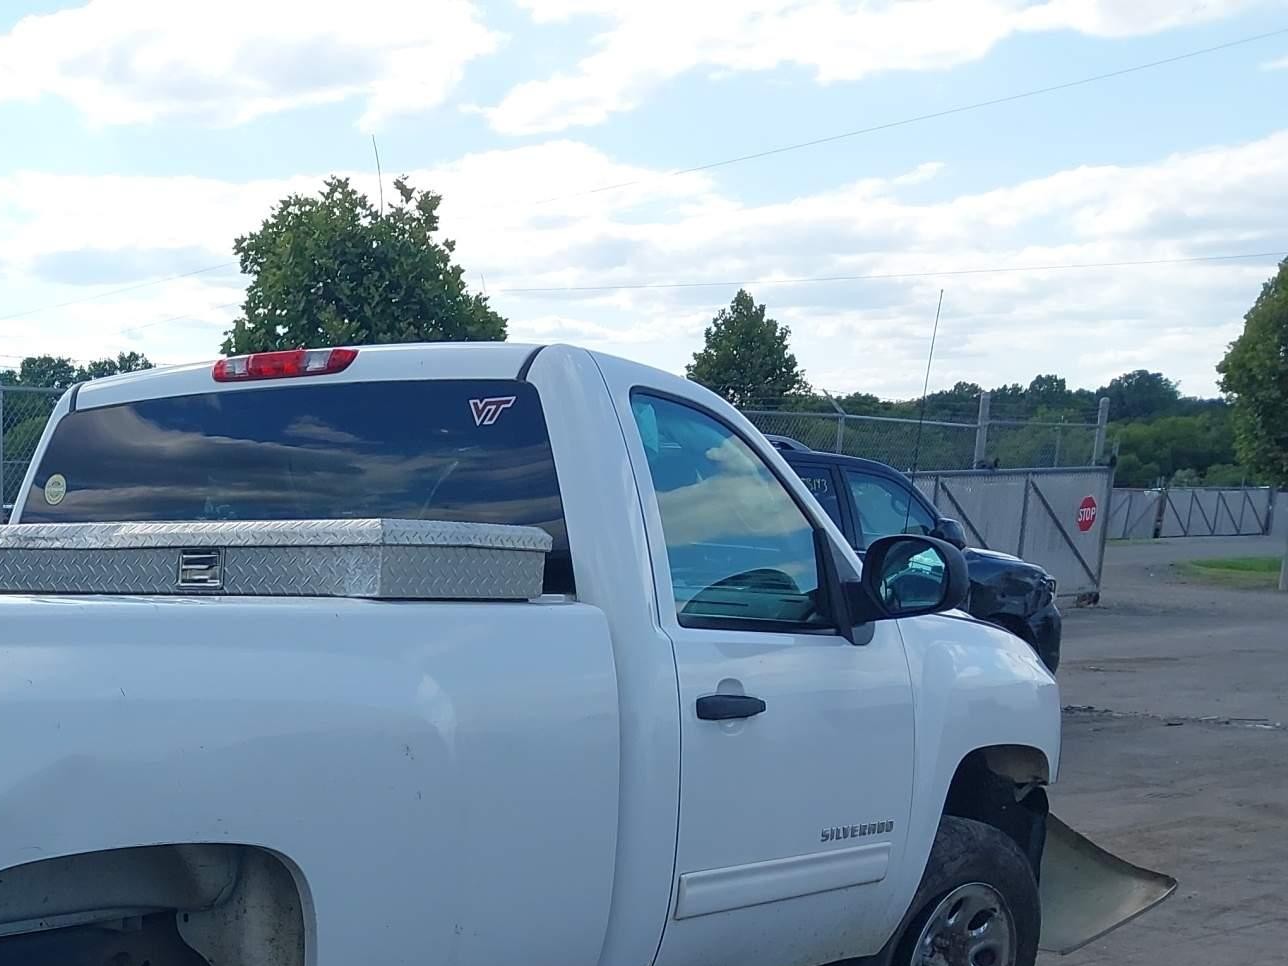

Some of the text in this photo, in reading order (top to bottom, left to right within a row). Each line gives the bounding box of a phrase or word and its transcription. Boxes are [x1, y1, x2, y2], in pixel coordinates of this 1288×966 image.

[469, 396, 516, 426] VT
[1078, 507, 1096, 521] STOP
[820, 820, 894, 842] SILVERADO
